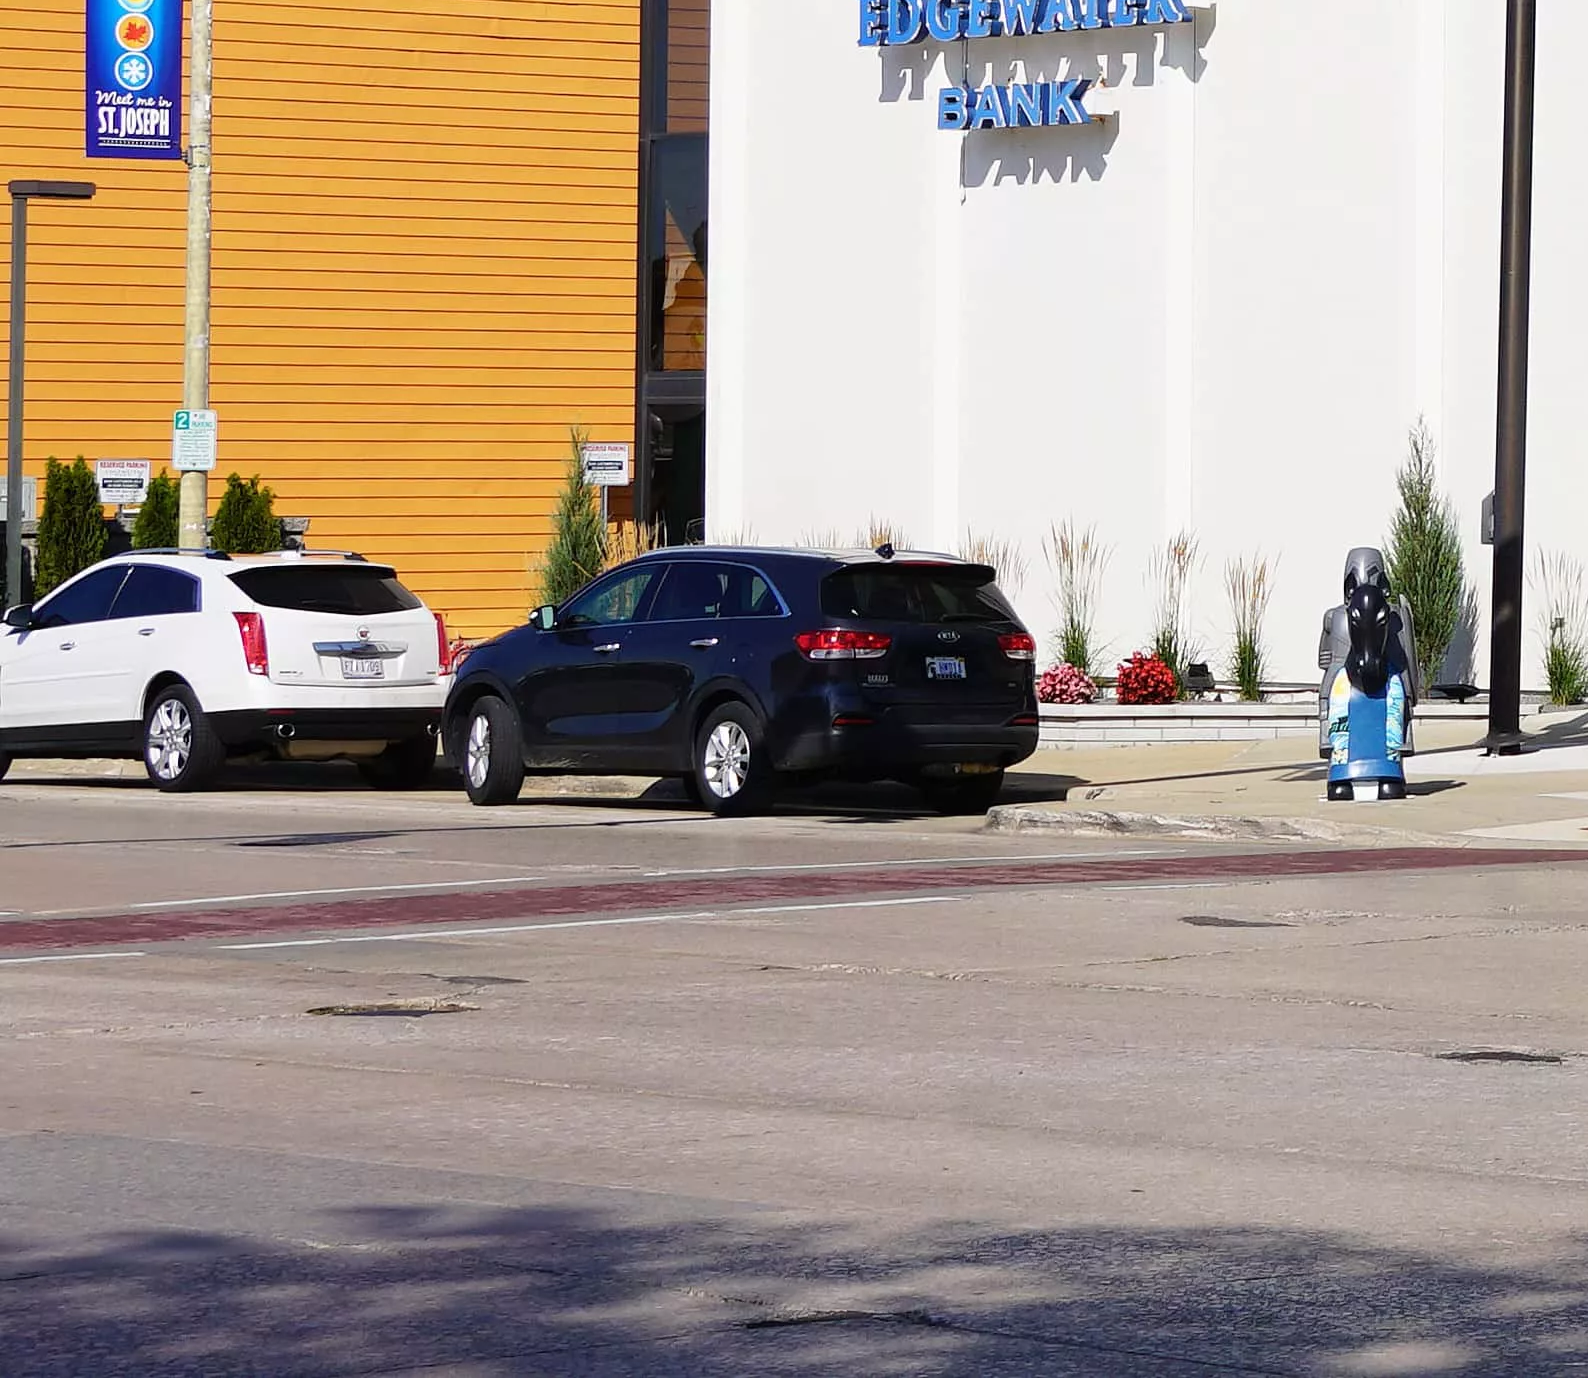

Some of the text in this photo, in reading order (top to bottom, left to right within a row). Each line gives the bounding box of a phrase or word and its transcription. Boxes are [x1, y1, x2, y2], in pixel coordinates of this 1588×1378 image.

[95, 90, 173, 107] Meet me in
[937, 78, 1093, 131] BANK
[119, 107, 170, 137] JOSEPH
[177, 412, 188, 428] 2
